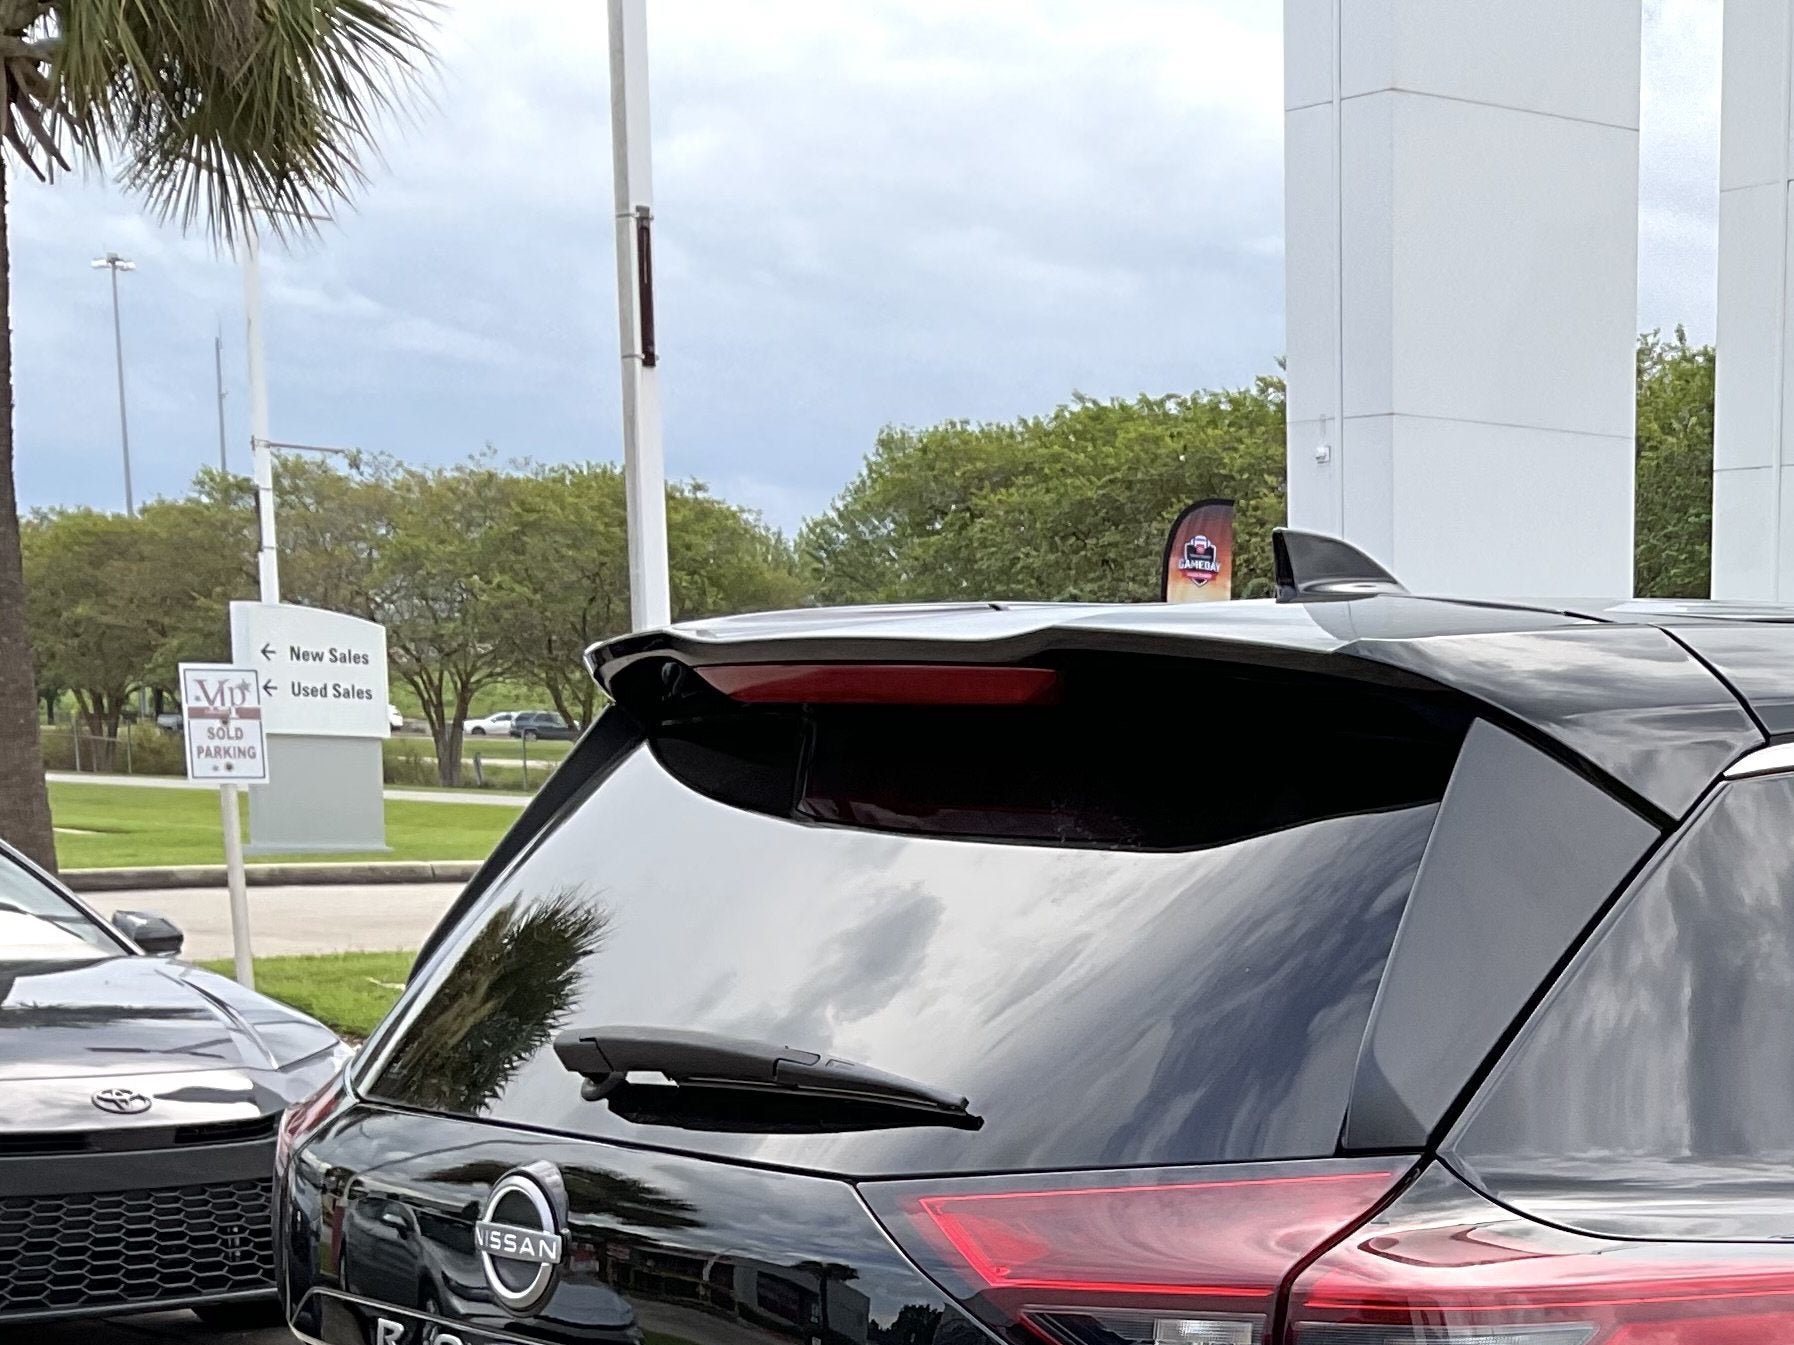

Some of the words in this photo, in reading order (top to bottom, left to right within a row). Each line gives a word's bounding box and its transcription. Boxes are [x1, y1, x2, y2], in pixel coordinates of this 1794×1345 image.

[1178, 559, 1221, 572] GAMEDAY
[289, 645, 324, 662] New
[328, 648, 370, 665] Sales
[291, 681, 328, 698] Used
[332, 684, 373, 701] Sales
[207, 726, 244, 741] SOLD
[196, 745, 257, 759] PARKING
[476, 1228, 557, 1260] NISSAN
